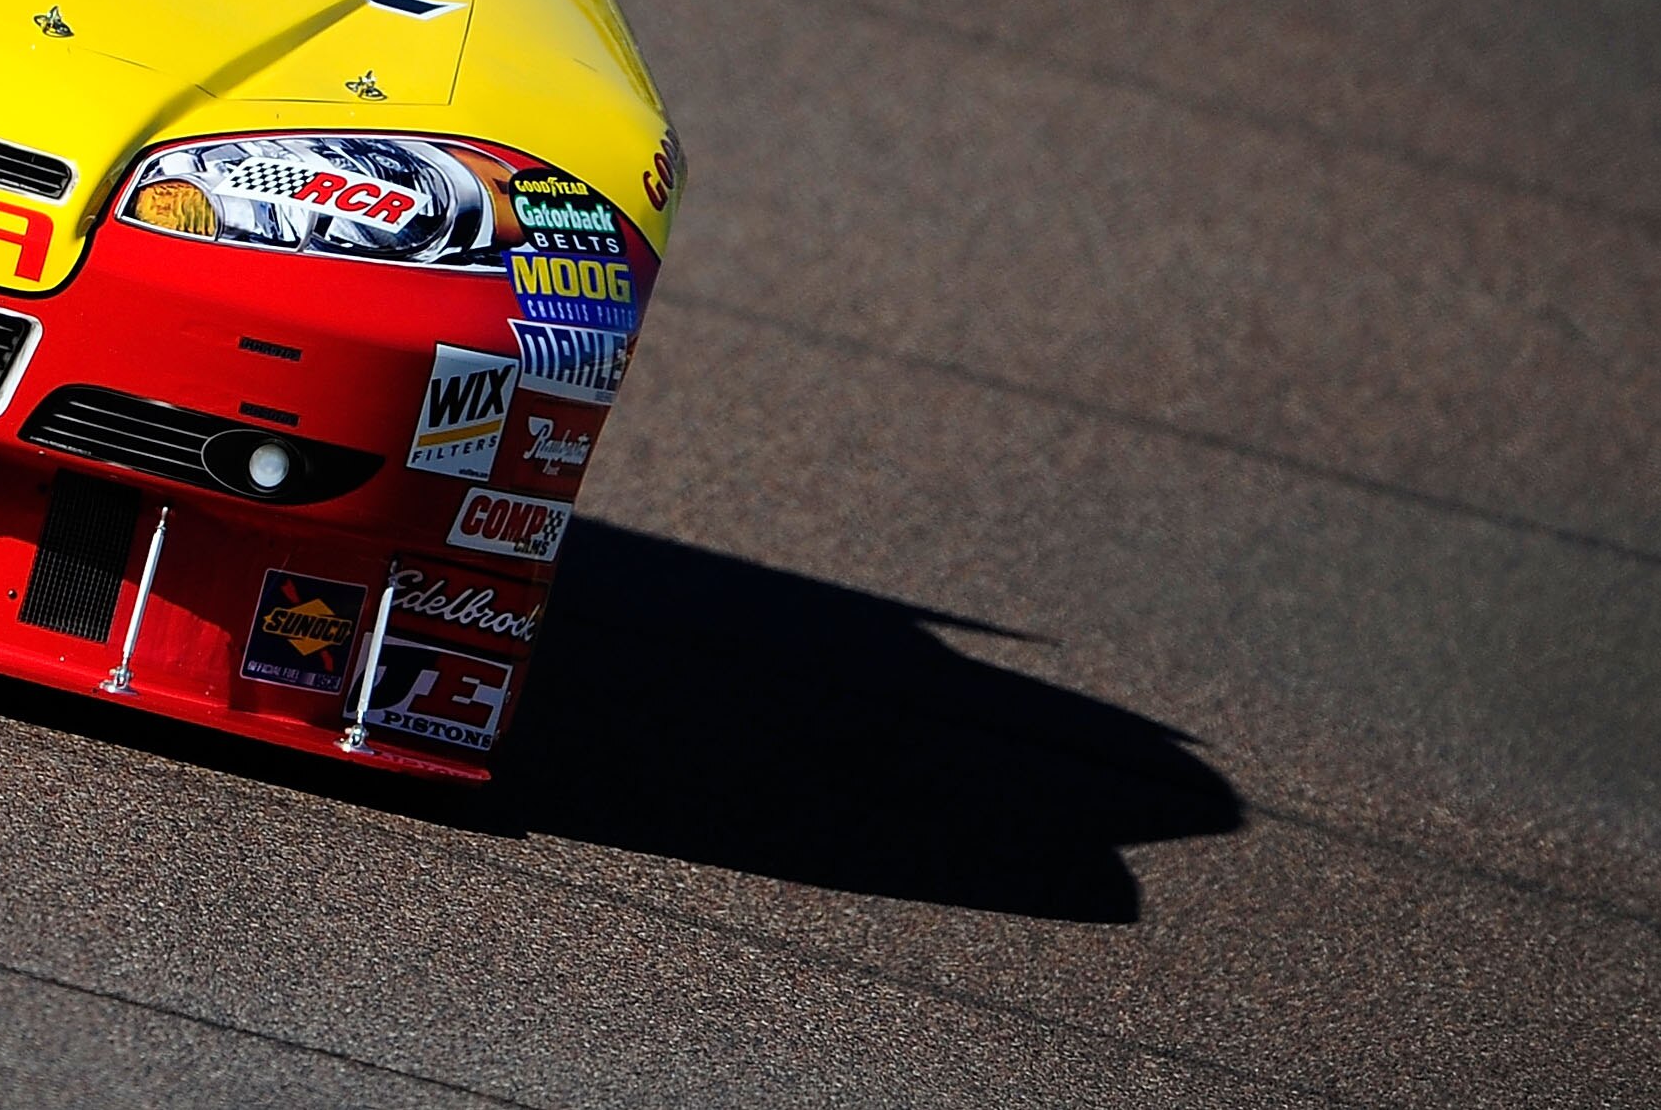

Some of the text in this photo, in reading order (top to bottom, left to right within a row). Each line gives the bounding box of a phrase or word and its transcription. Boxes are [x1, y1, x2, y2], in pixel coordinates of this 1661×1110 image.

[294, 171, 417, 225] RCR
[514, 177, 590, 197] GOODYEAR
[514, 194, 616, 233] Gatorback
[533, 232, 620, 253] BELTS
[511, 255, 632, 303] MOOG
[526, 299, 590, 322] CHASSIS
[429, 364, 516, 428] WIX
[411, 435, 498, 463] FILTERS
[461, 495, 548, 542] COMP
[514, 538, 550, 557] CAMS
[391, 568, 541, 642] Edelbrock
[265, 610, 351, 644] SUNOCO
[346, 644, 507, 729] JE
[381, 709, 493, 749] PISTONS
